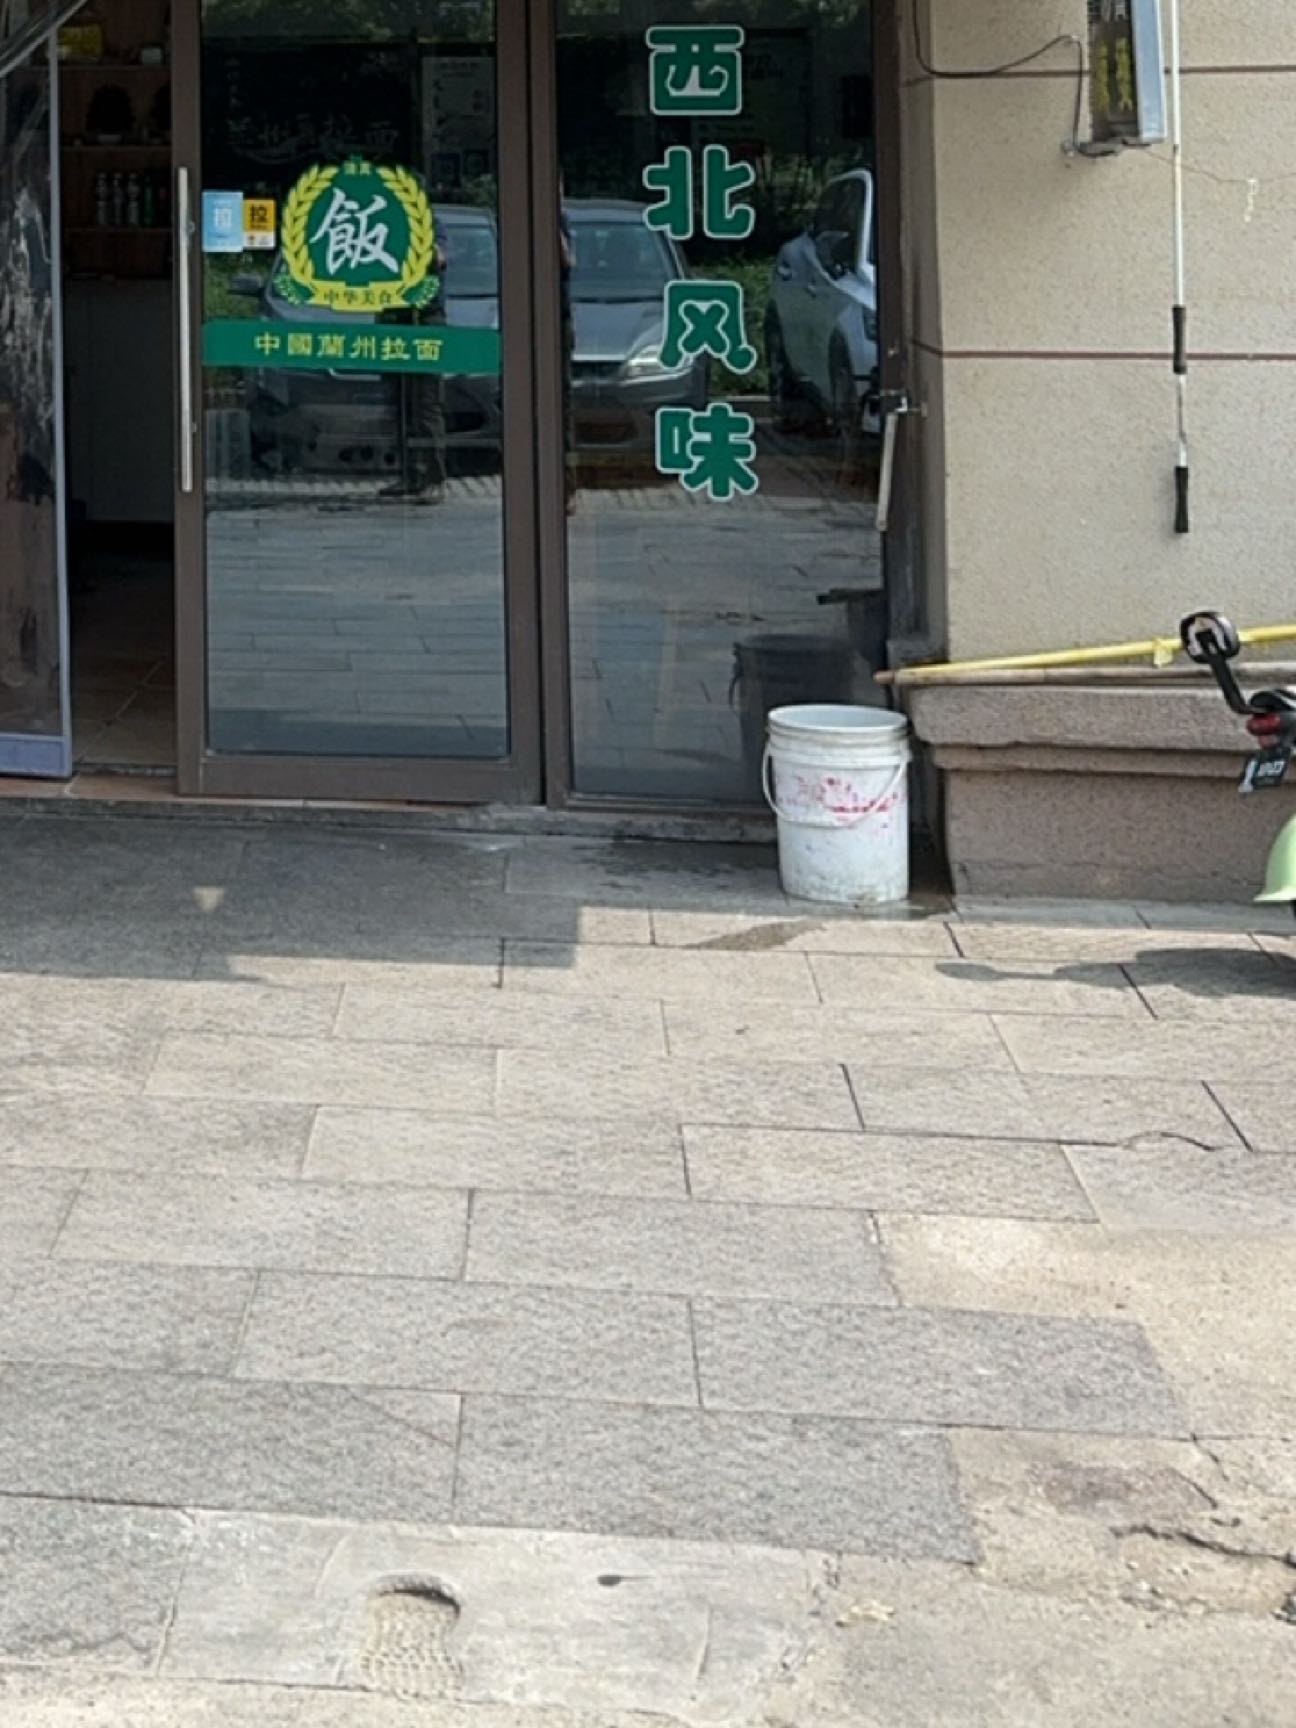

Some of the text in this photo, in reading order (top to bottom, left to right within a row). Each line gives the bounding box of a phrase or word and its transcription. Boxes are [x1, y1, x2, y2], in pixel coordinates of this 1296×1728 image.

[309, 187, 399, 275] 飯
[642, 24, 759, 501] 西北风味
[255, 331, 444, 361] 中國蘭州拉面
